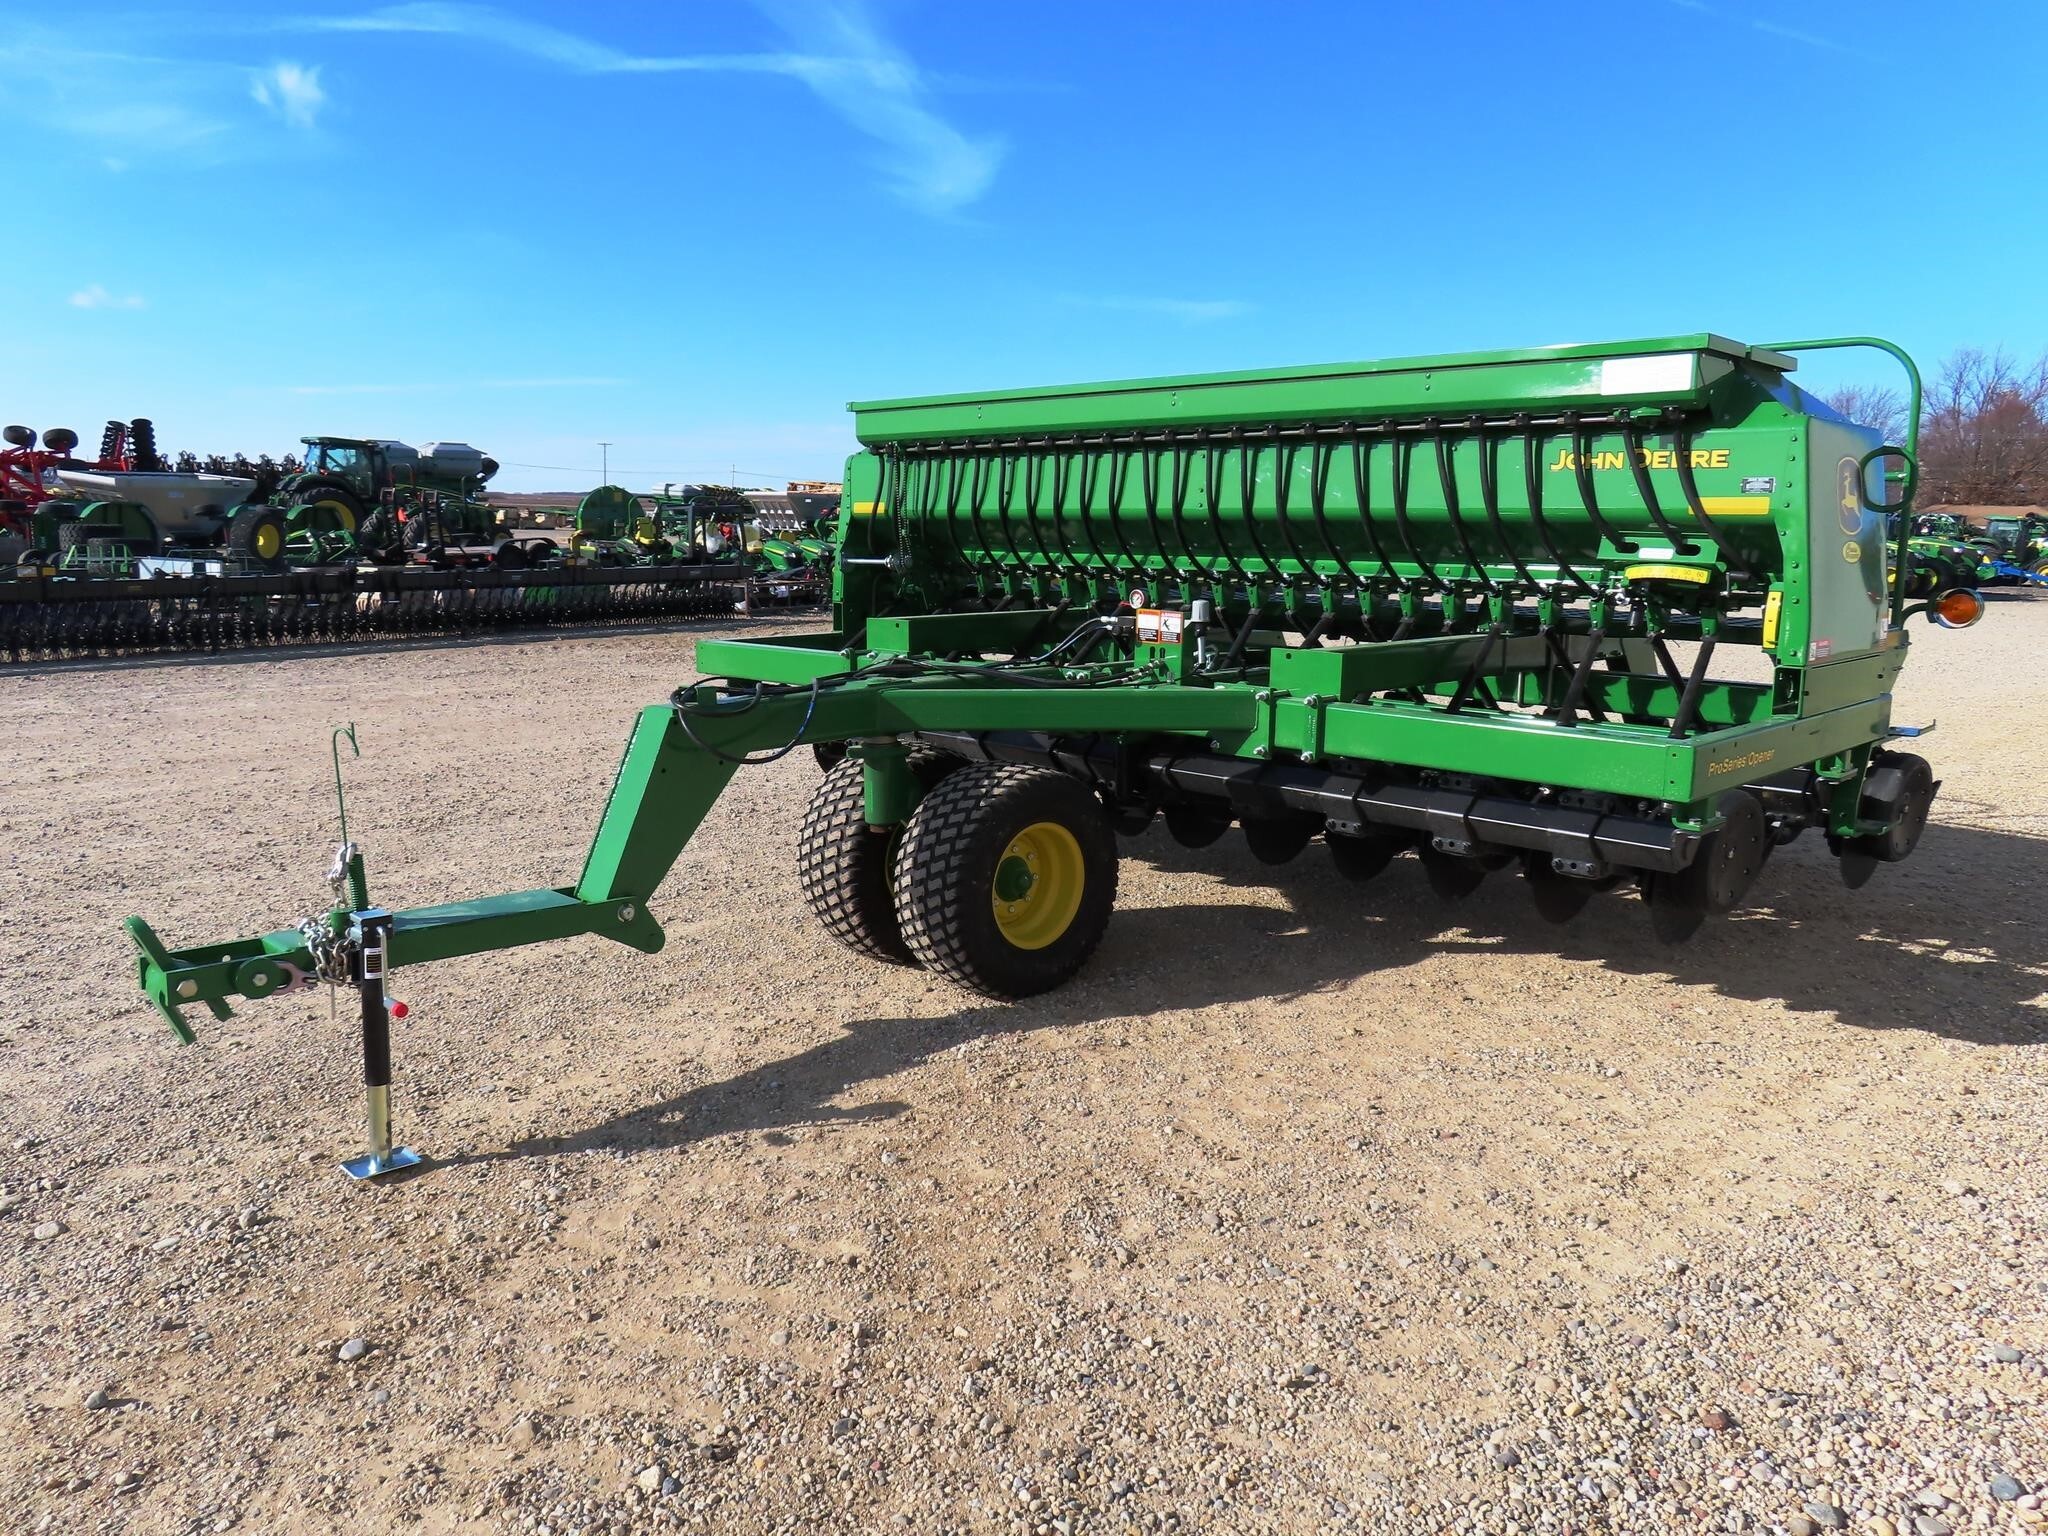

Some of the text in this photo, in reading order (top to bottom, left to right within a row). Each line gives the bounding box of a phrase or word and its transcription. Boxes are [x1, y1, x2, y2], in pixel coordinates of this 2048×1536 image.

[1550, 449, 1624, 470] JOHN
[1708, 749, 1775, 777] ProSeries Opener
